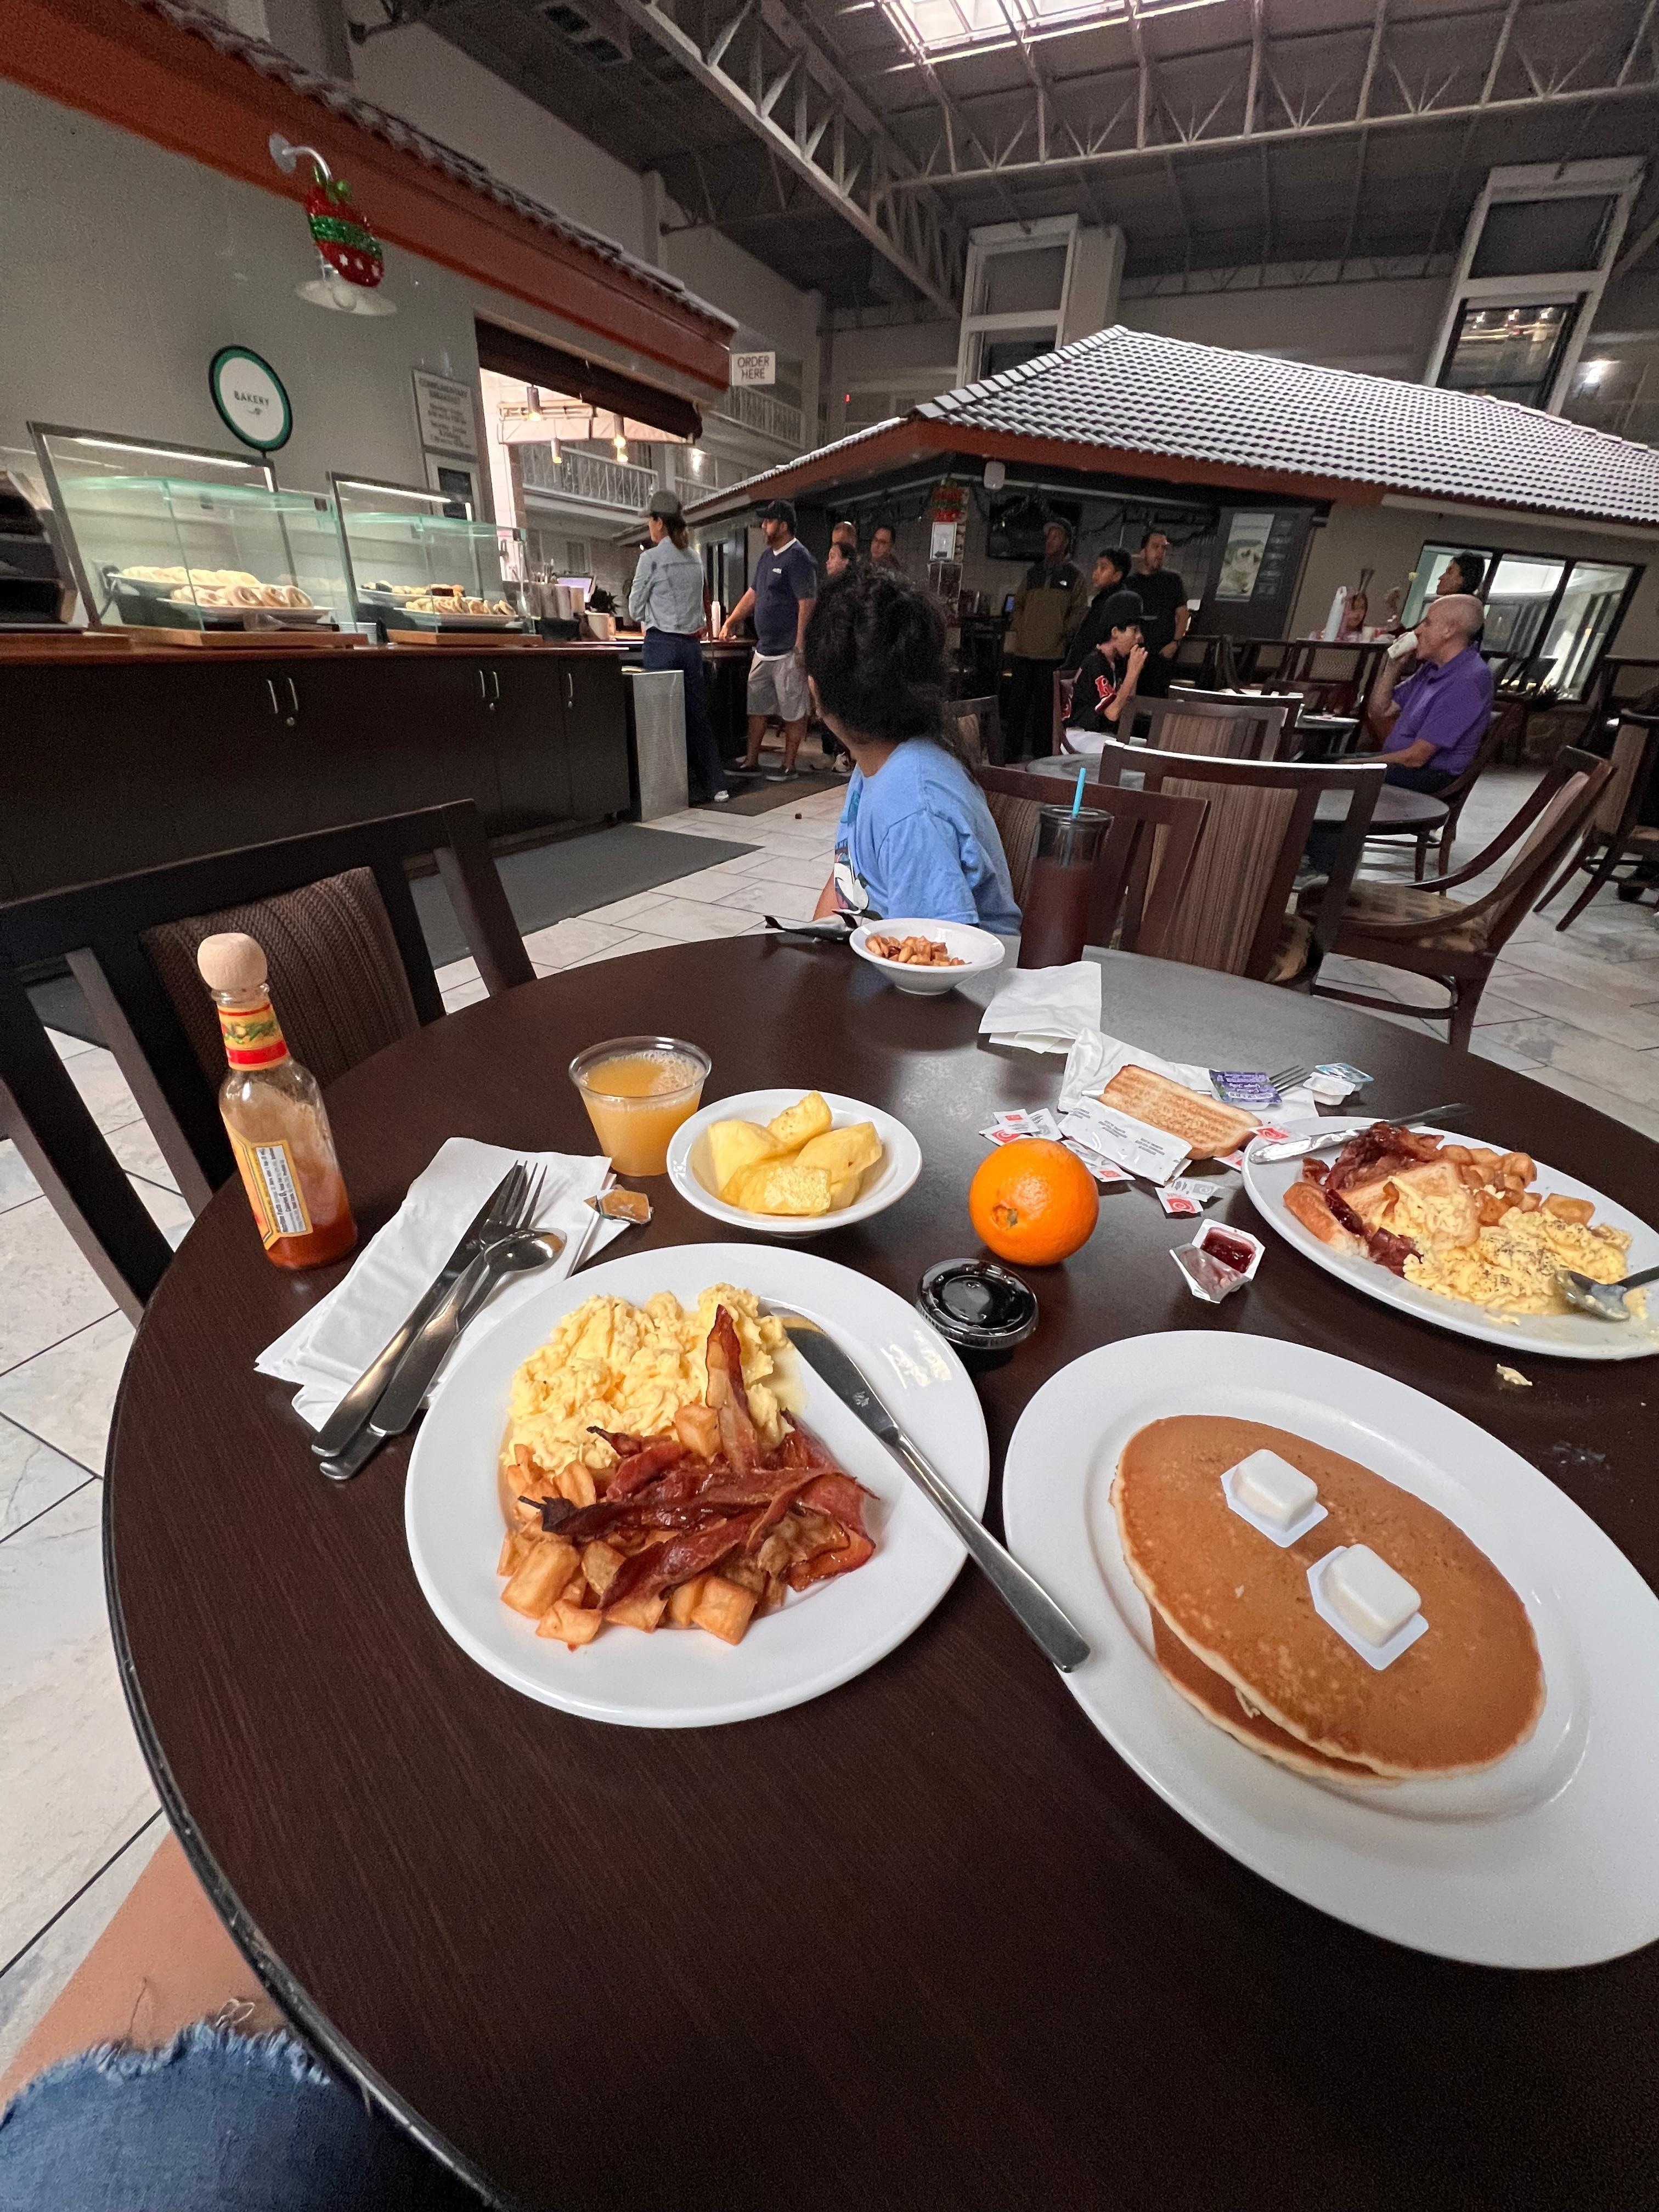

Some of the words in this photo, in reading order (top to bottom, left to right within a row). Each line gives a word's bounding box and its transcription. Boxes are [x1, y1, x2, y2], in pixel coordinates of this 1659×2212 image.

[737, 355, 769, 368] ORDER
[741, 368, 765, 380] HERE
[233, 390, 269, 406] BAKERY
